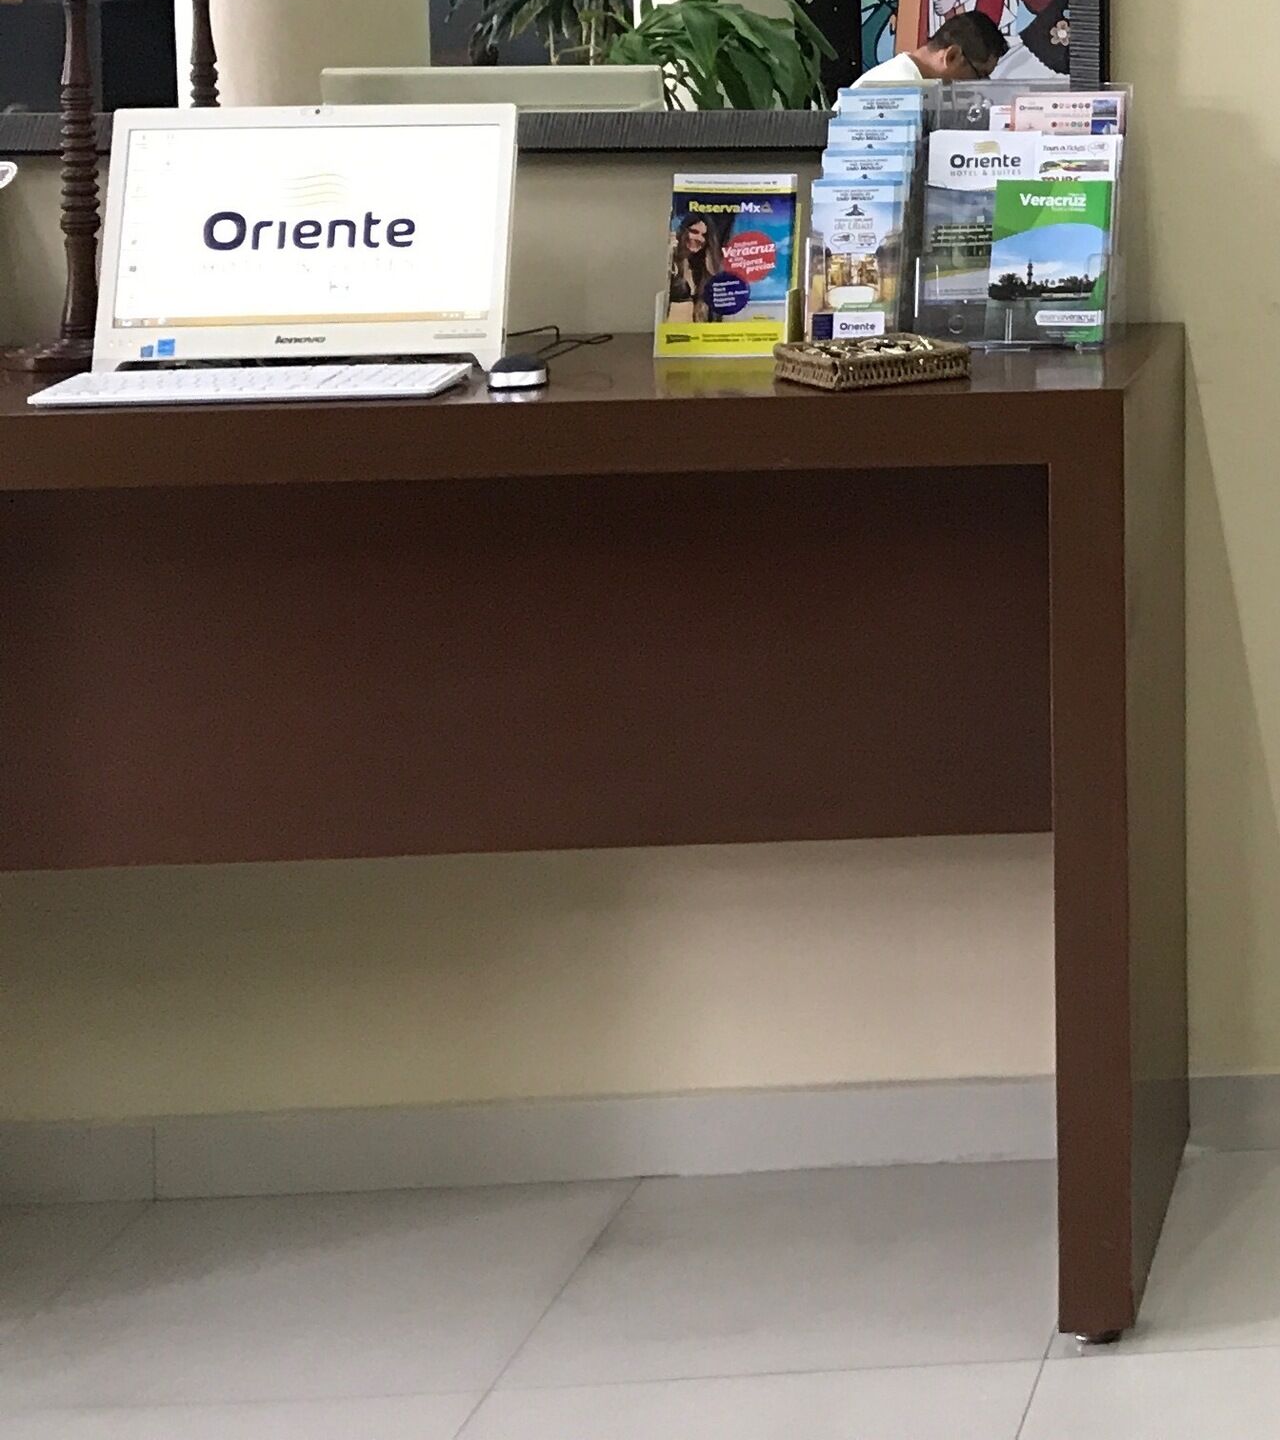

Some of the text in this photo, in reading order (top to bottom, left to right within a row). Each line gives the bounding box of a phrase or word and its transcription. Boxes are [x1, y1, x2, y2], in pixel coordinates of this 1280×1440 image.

[950, 154, 1021, 168] Oriente
[1020, 192, 1086, 207] Veracruz
[689, 201, 761, 214] ReservaMx
[203, 210, 416, 252] Oriente
[721, 243, 776, 258] Veracruz
[839, 322, 876, 331] Oriente
